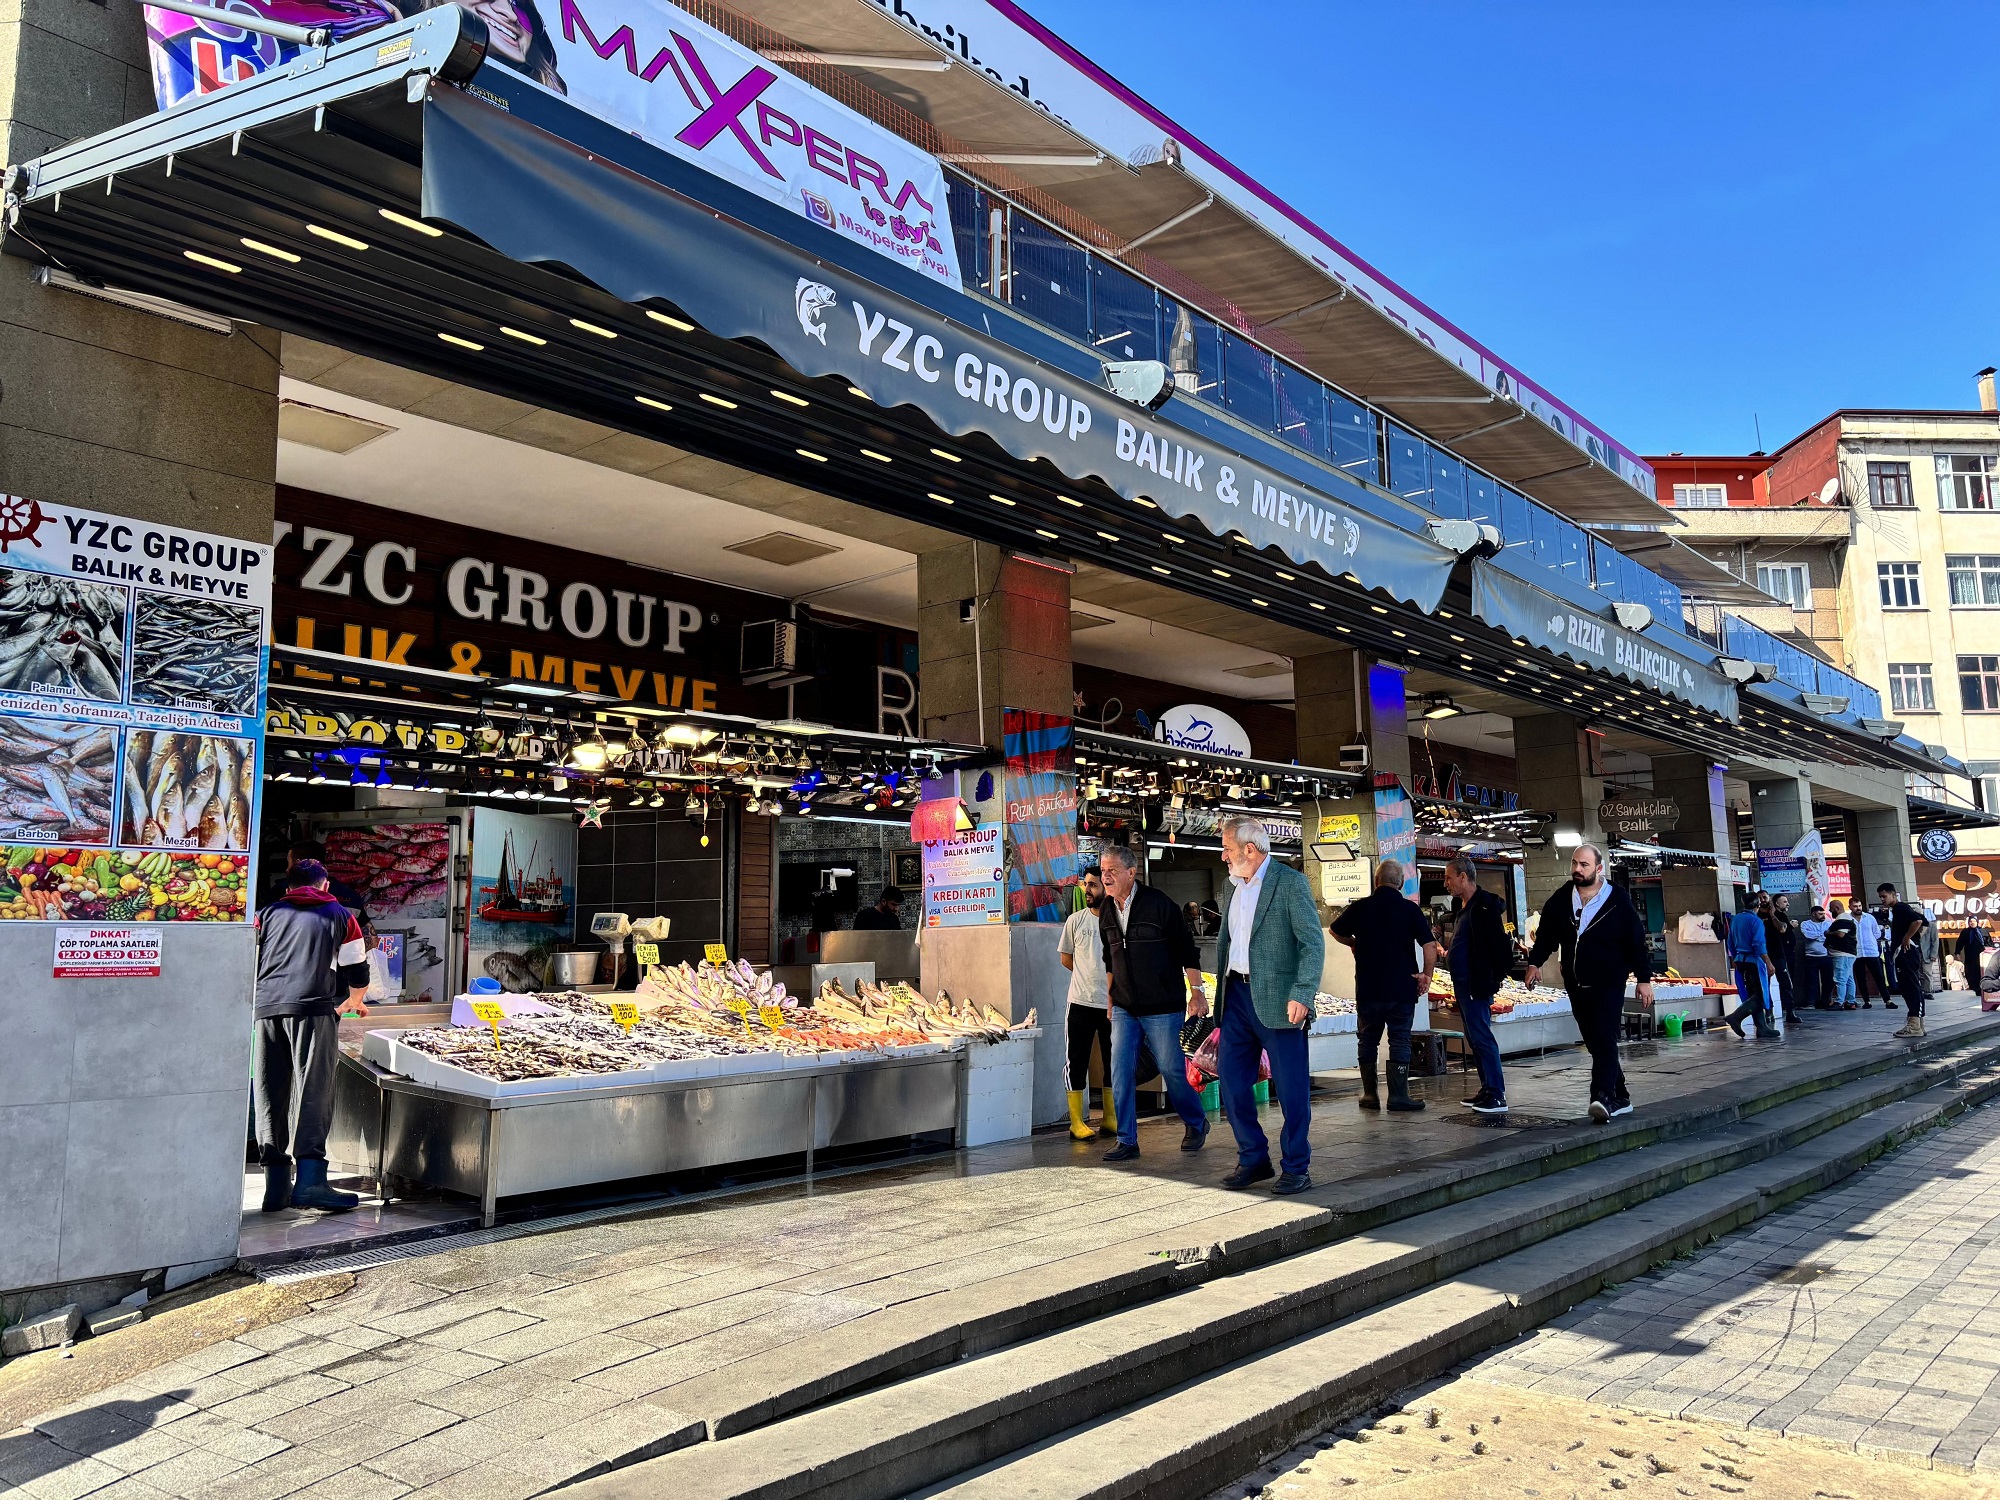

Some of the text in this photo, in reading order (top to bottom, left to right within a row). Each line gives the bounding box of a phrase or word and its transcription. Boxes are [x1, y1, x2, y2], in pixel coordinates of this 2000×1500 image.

[861, 196, 886, 227] iç
[852, 301, 1338, 547] YZC GROUP BALIK & MEYVE
[63, 514, 260, 574] YZC GROUP
[71, 554, 249, 600] BALIK & MEYVE
[446, 556, 703, 655] GROUP
[1567, 614, 1681, 688] RIZIK BALIKÇILIK
[32, 682, 76, 696] Palamut
[176, 697, 213, 710] Hamsi
[1, 698, 241, 731] enizden Sofranıza, Tazeliğin Adresi
[17, 828, 57, 840] Barbon
[962, 830, 998, 844] GROUP
[165, 836, 198, 848] Mezgit
[944, 848, 964, 857] BALIK
[971, 845, 994, 854] MEYVE
[933, 888, 963, 902] KREDİ
[965, 887, 996, 899] KARTI
[90, 930, 131, 938] DİKKAT!
[60, 939, 159, 948] ÇÖP TOPLAMA SAATLERİ
[62, 951, 155, 959] 12.00 15.30 19.30
